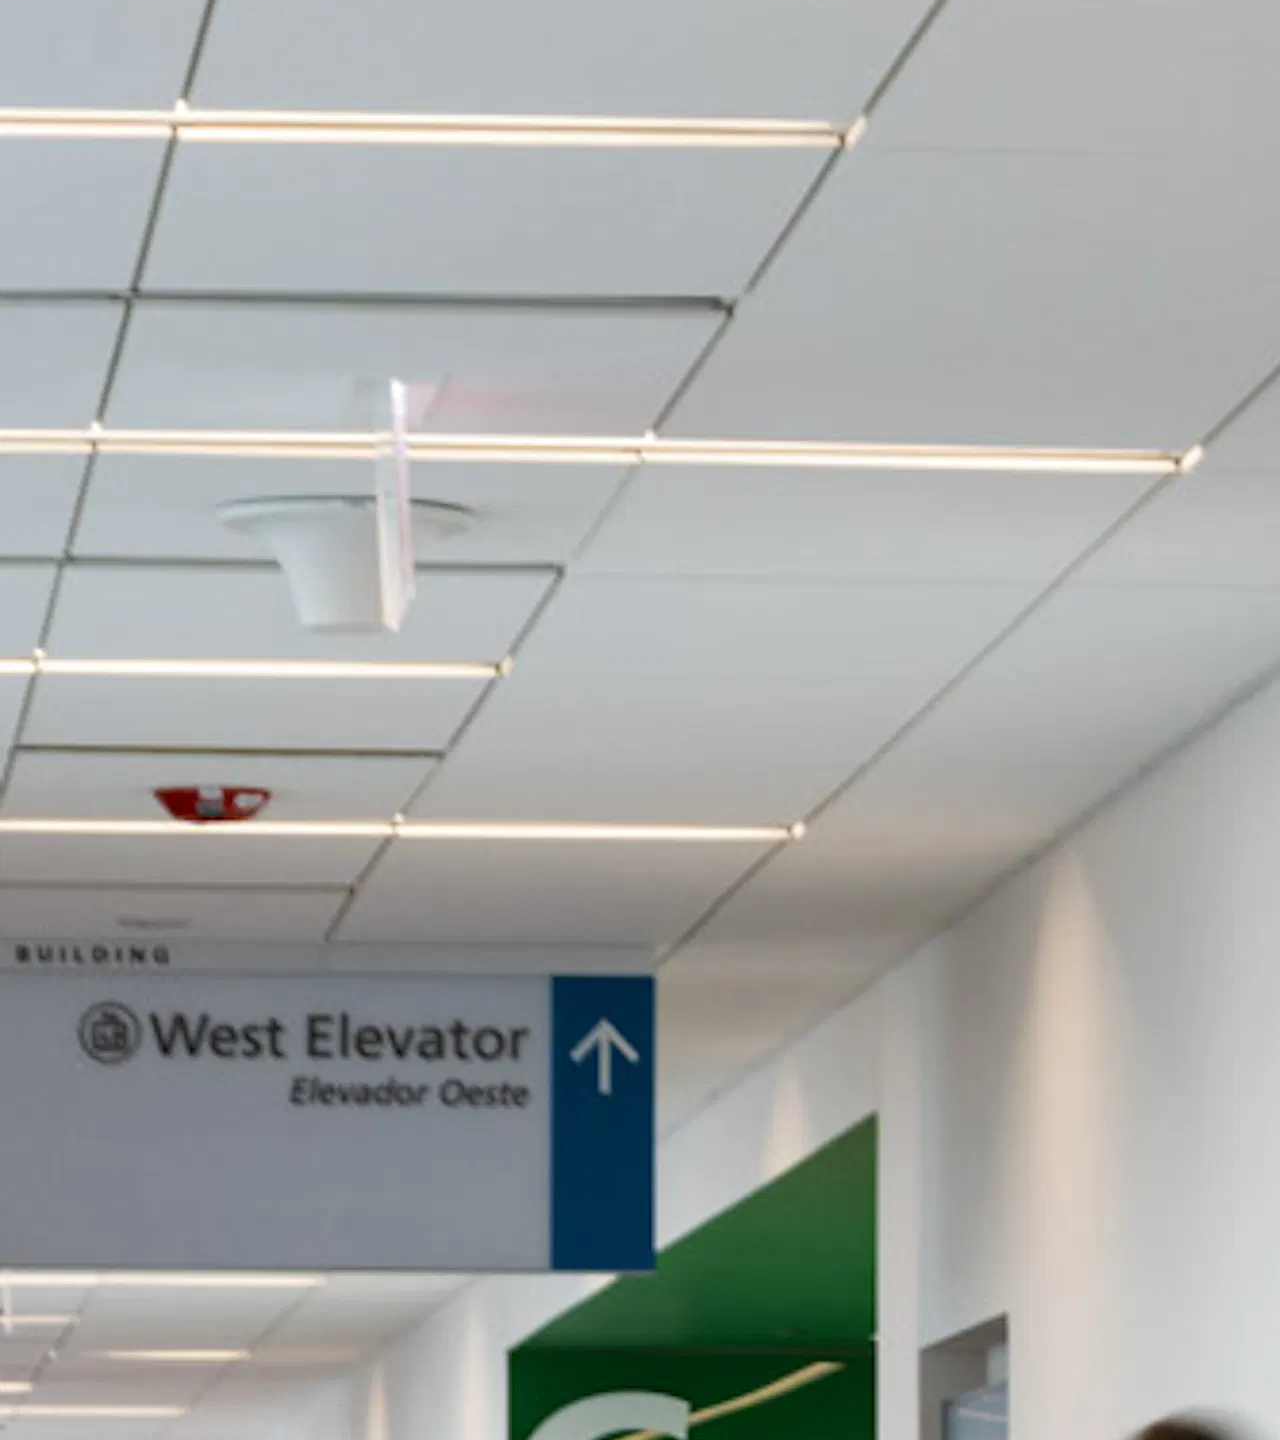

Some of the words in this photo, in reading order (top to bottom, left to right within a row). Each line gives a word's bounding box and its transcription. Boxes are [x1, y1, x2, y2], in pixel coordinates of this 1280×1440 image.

[14, 943, 170, 965] BUILDING
[149, 1013, 286, 1059] West
[306, 1013, 529, 1060] Elevator
[290, 1077, 428, 1107] Elevador
[439, 1079, 530, 1108] Oeste
